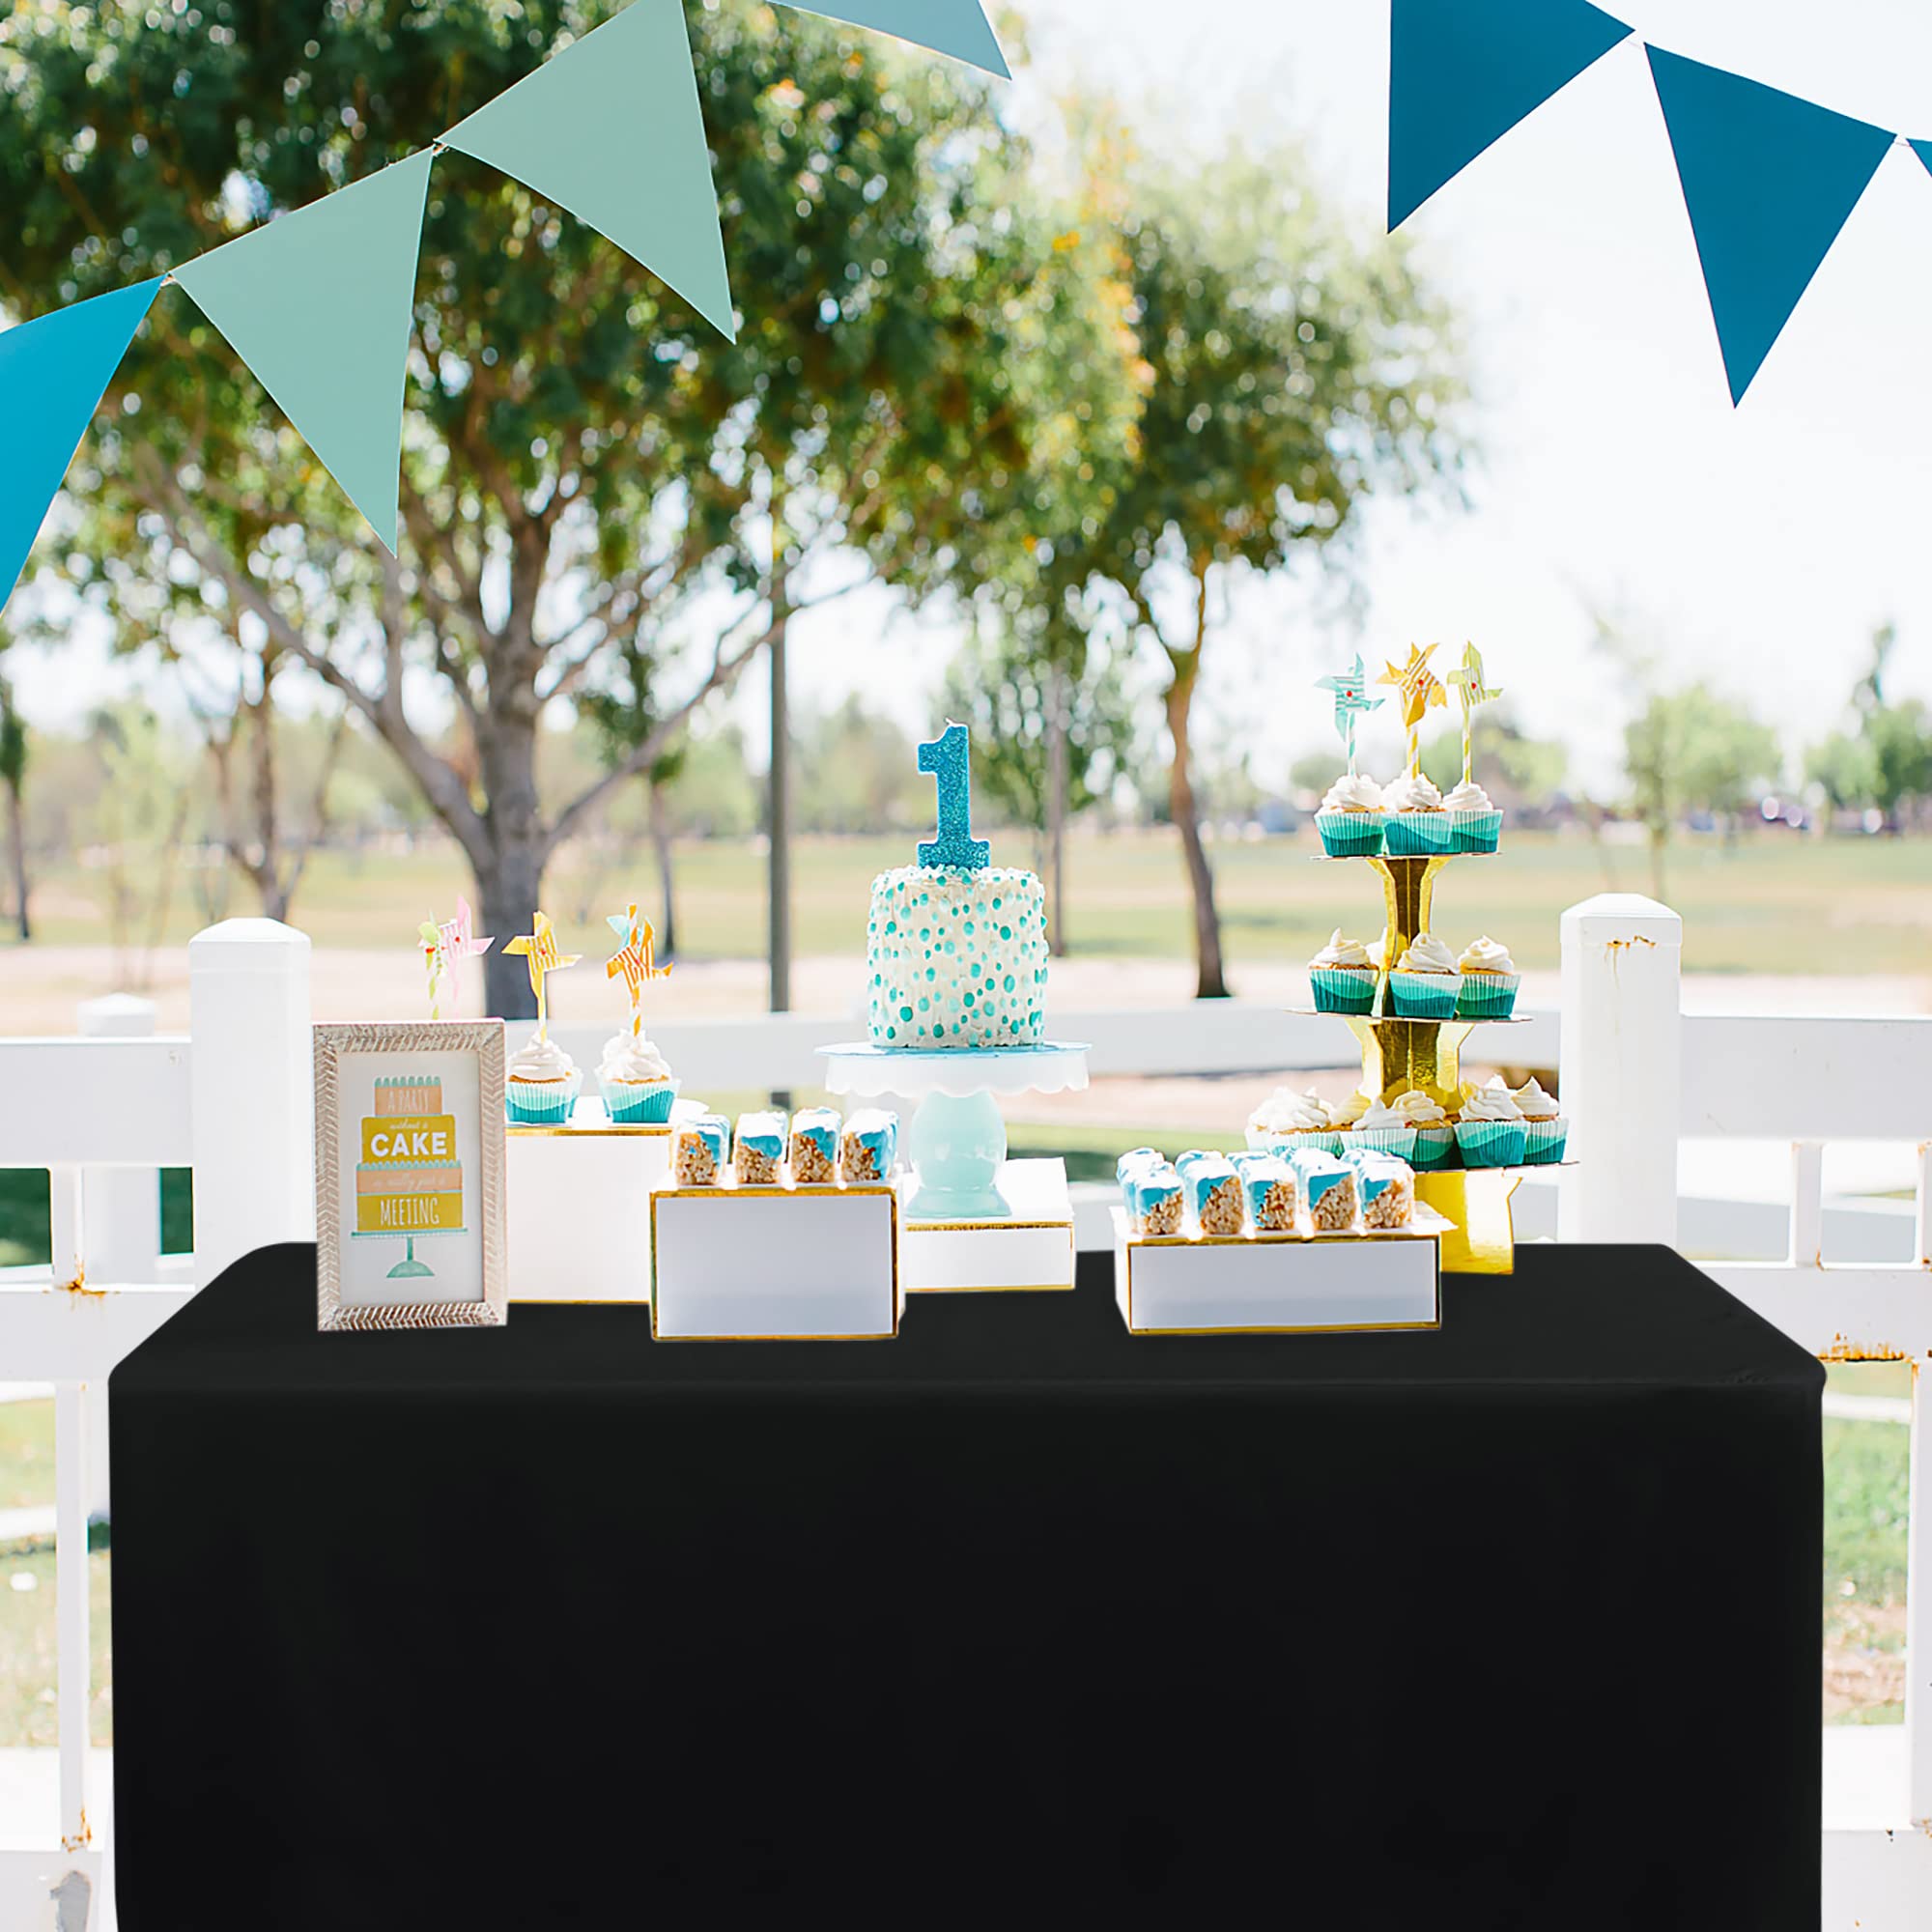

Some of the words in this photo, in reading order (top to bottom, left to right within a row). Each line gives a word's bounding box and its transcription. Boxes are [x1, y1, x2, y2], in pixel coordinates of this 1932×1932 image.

[917, 724, 990, 869] 1
[398, 1088, 430, 1113] PARTY
[371, 1131, 447, 1156] CAKE
[381, 1197, 440, 1226] MEETING
